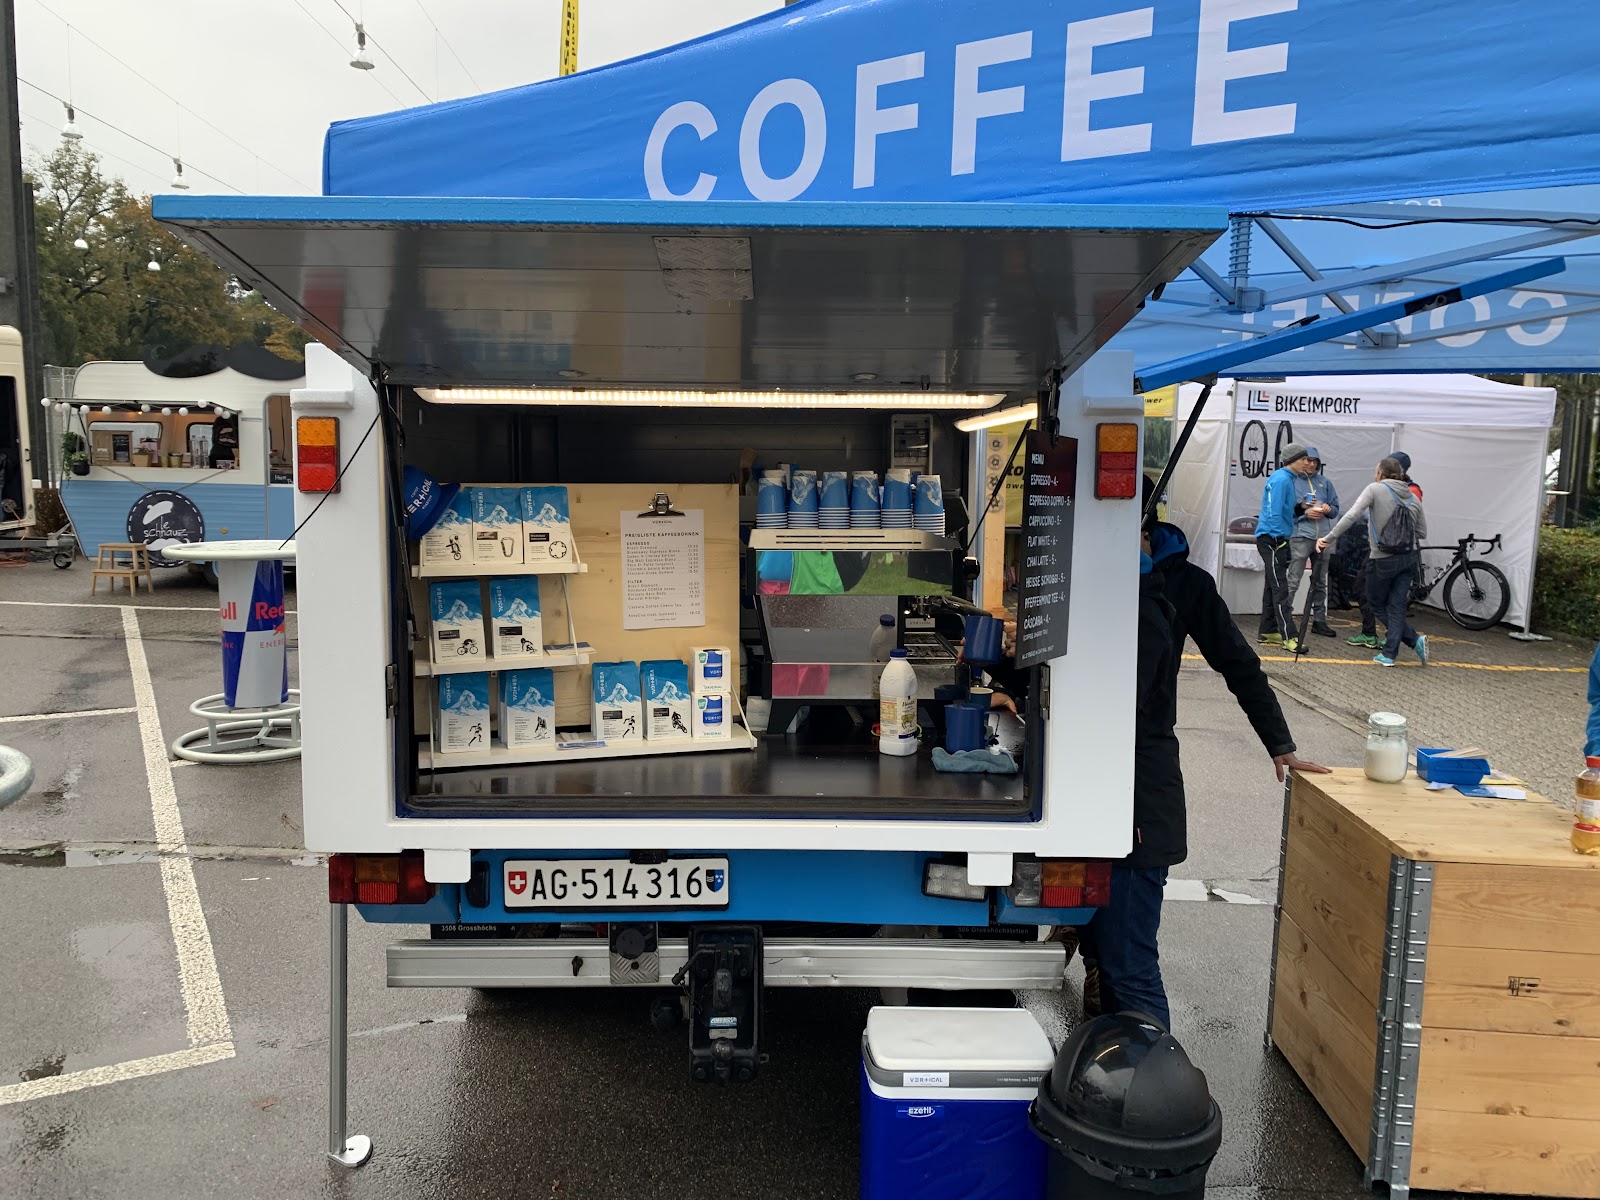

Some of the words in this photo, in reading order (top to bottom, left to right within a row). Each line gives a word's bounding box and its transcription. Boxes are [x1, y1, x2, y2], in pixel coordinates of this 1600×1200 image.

[643, 0, 1298, 201] COFFEE
[1275, 395, 1361, 414] BIKEIMPORT
[1031, 453, 1045, 465] MENU
[1030, 474, 1051, 486] ESPRESSO
[1029, 495, 1050, 506] ESPRESSO
[1050, 496, 1064, 506] DOPPIO
[1028, 515, 1054, 526] CAPPUCCINO
[1027, 535, 1037, 547] FLAT
[1037, 535, 1050, 546] WHITE
[1027, 556, 1037, 567] CHAI
[1037, 555, 1049, 566] LATTE
[1025, 576, 1040, 588] HEISSE
[1041, 573, 1058, 586] SCHOGGI
[1025, 593, 1052, 609] PFEFFERMINZ
[221, 602, 237, 620] ull
[256, 599, 284, 620] Red
